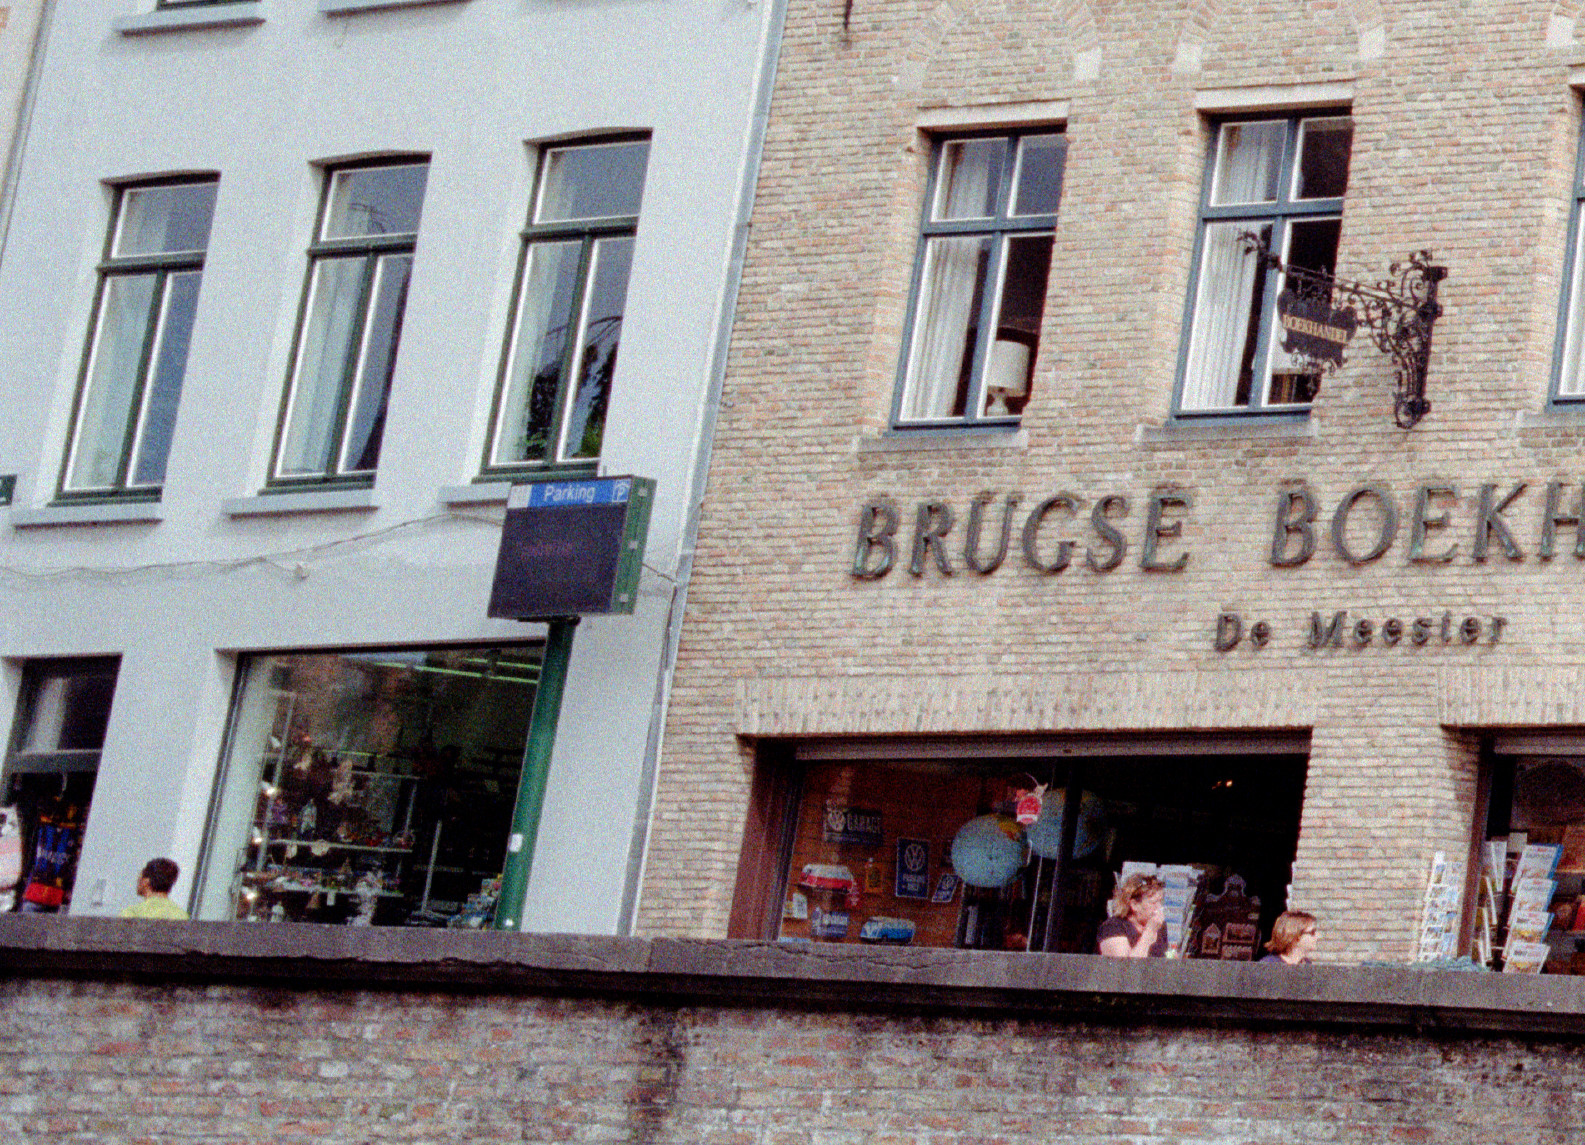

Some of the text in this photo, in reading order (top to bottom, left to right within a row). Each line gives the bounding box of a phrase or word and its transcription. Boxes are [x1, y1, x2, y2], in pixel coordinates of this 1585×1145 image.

[544, 485, 596, 503] Parking
[851, 489, 1195, 580] BRUGSE
[1214, 611, 1508, 652] De Meester
